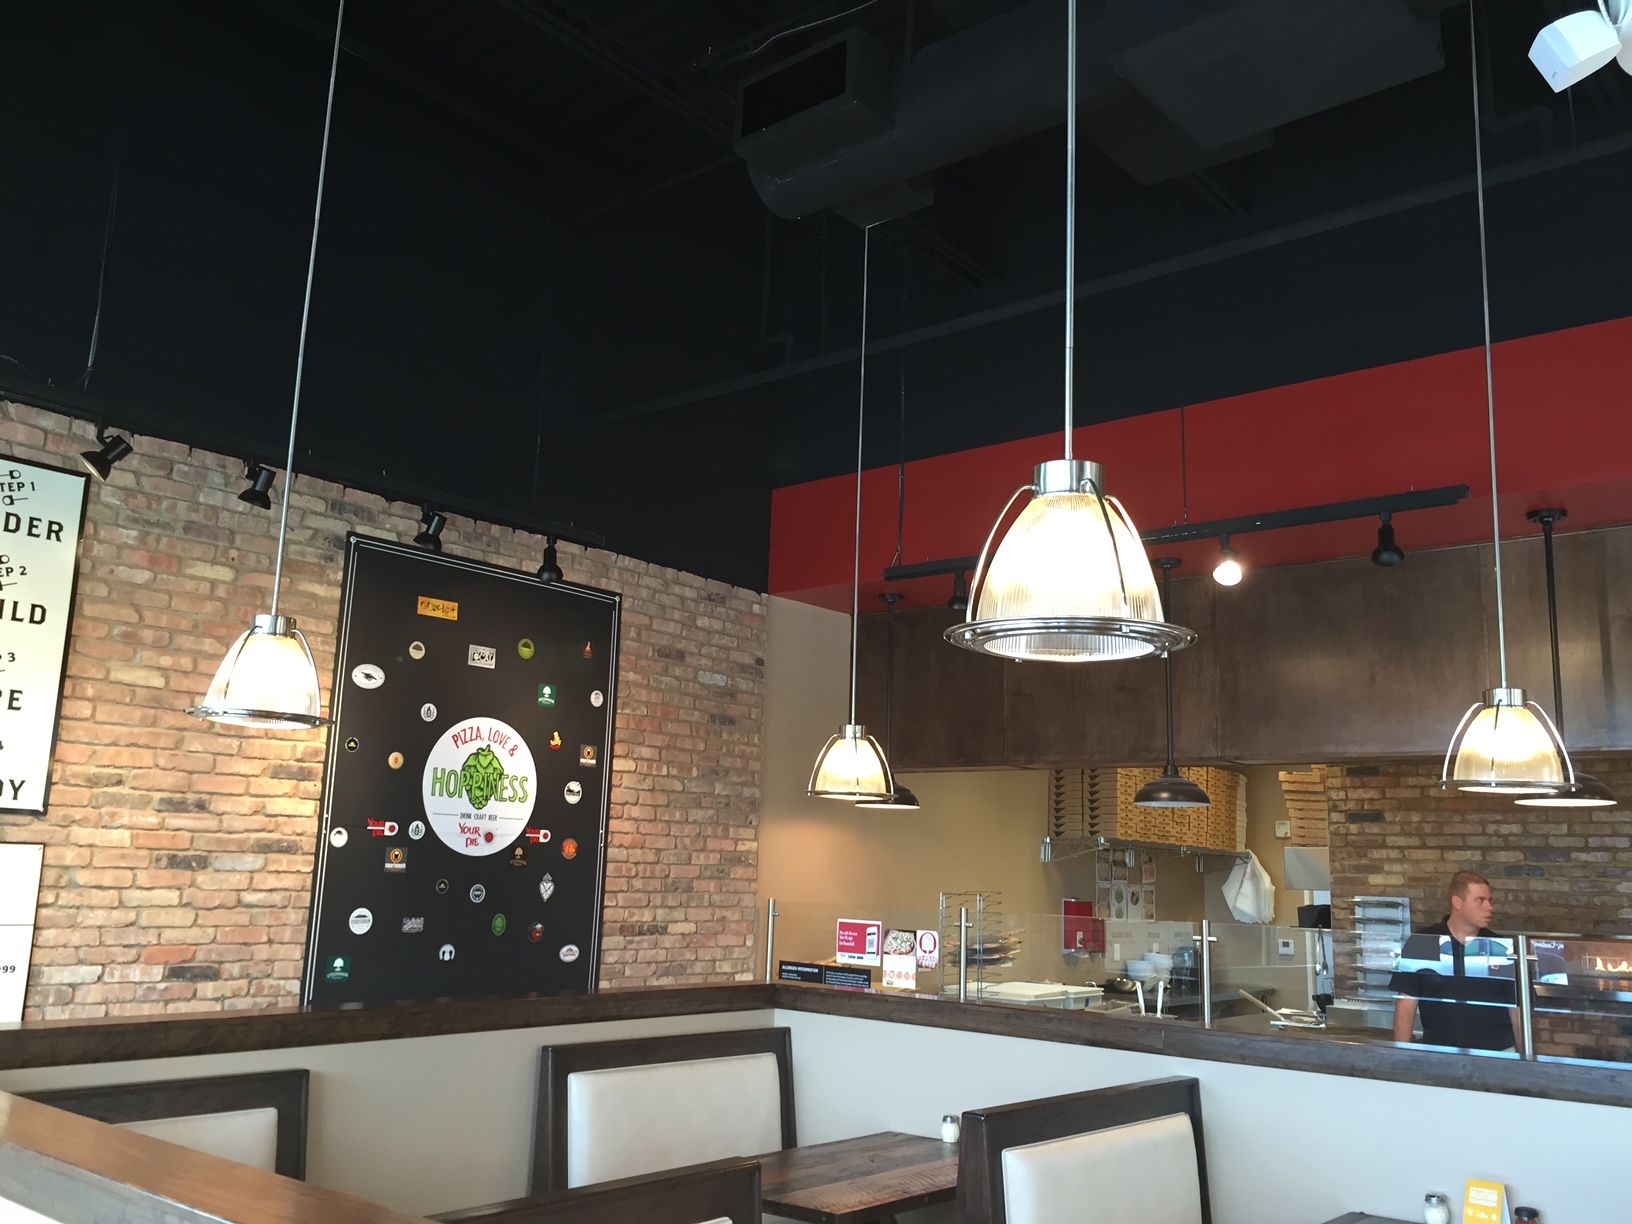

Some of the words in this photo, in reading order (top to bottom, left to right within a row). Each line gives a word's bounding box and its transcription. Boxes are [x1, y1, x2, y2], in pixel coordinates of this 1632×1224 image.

[30, 481, 36, 492] 1
[3, 511, 64, 543] DER
[19, 565, 28, 576] 2
[7, 651, 16, 663] 3
[451, 726, 485, 749] PIZZA,
[487, 727, 511, 750] LOVE
[508, 744, 519, 757] &
[431, 767, 529, 804] HOPPINESS
[460, 812, 472, 820] DRINK
[474, 813, 487, 821] CRAFT
